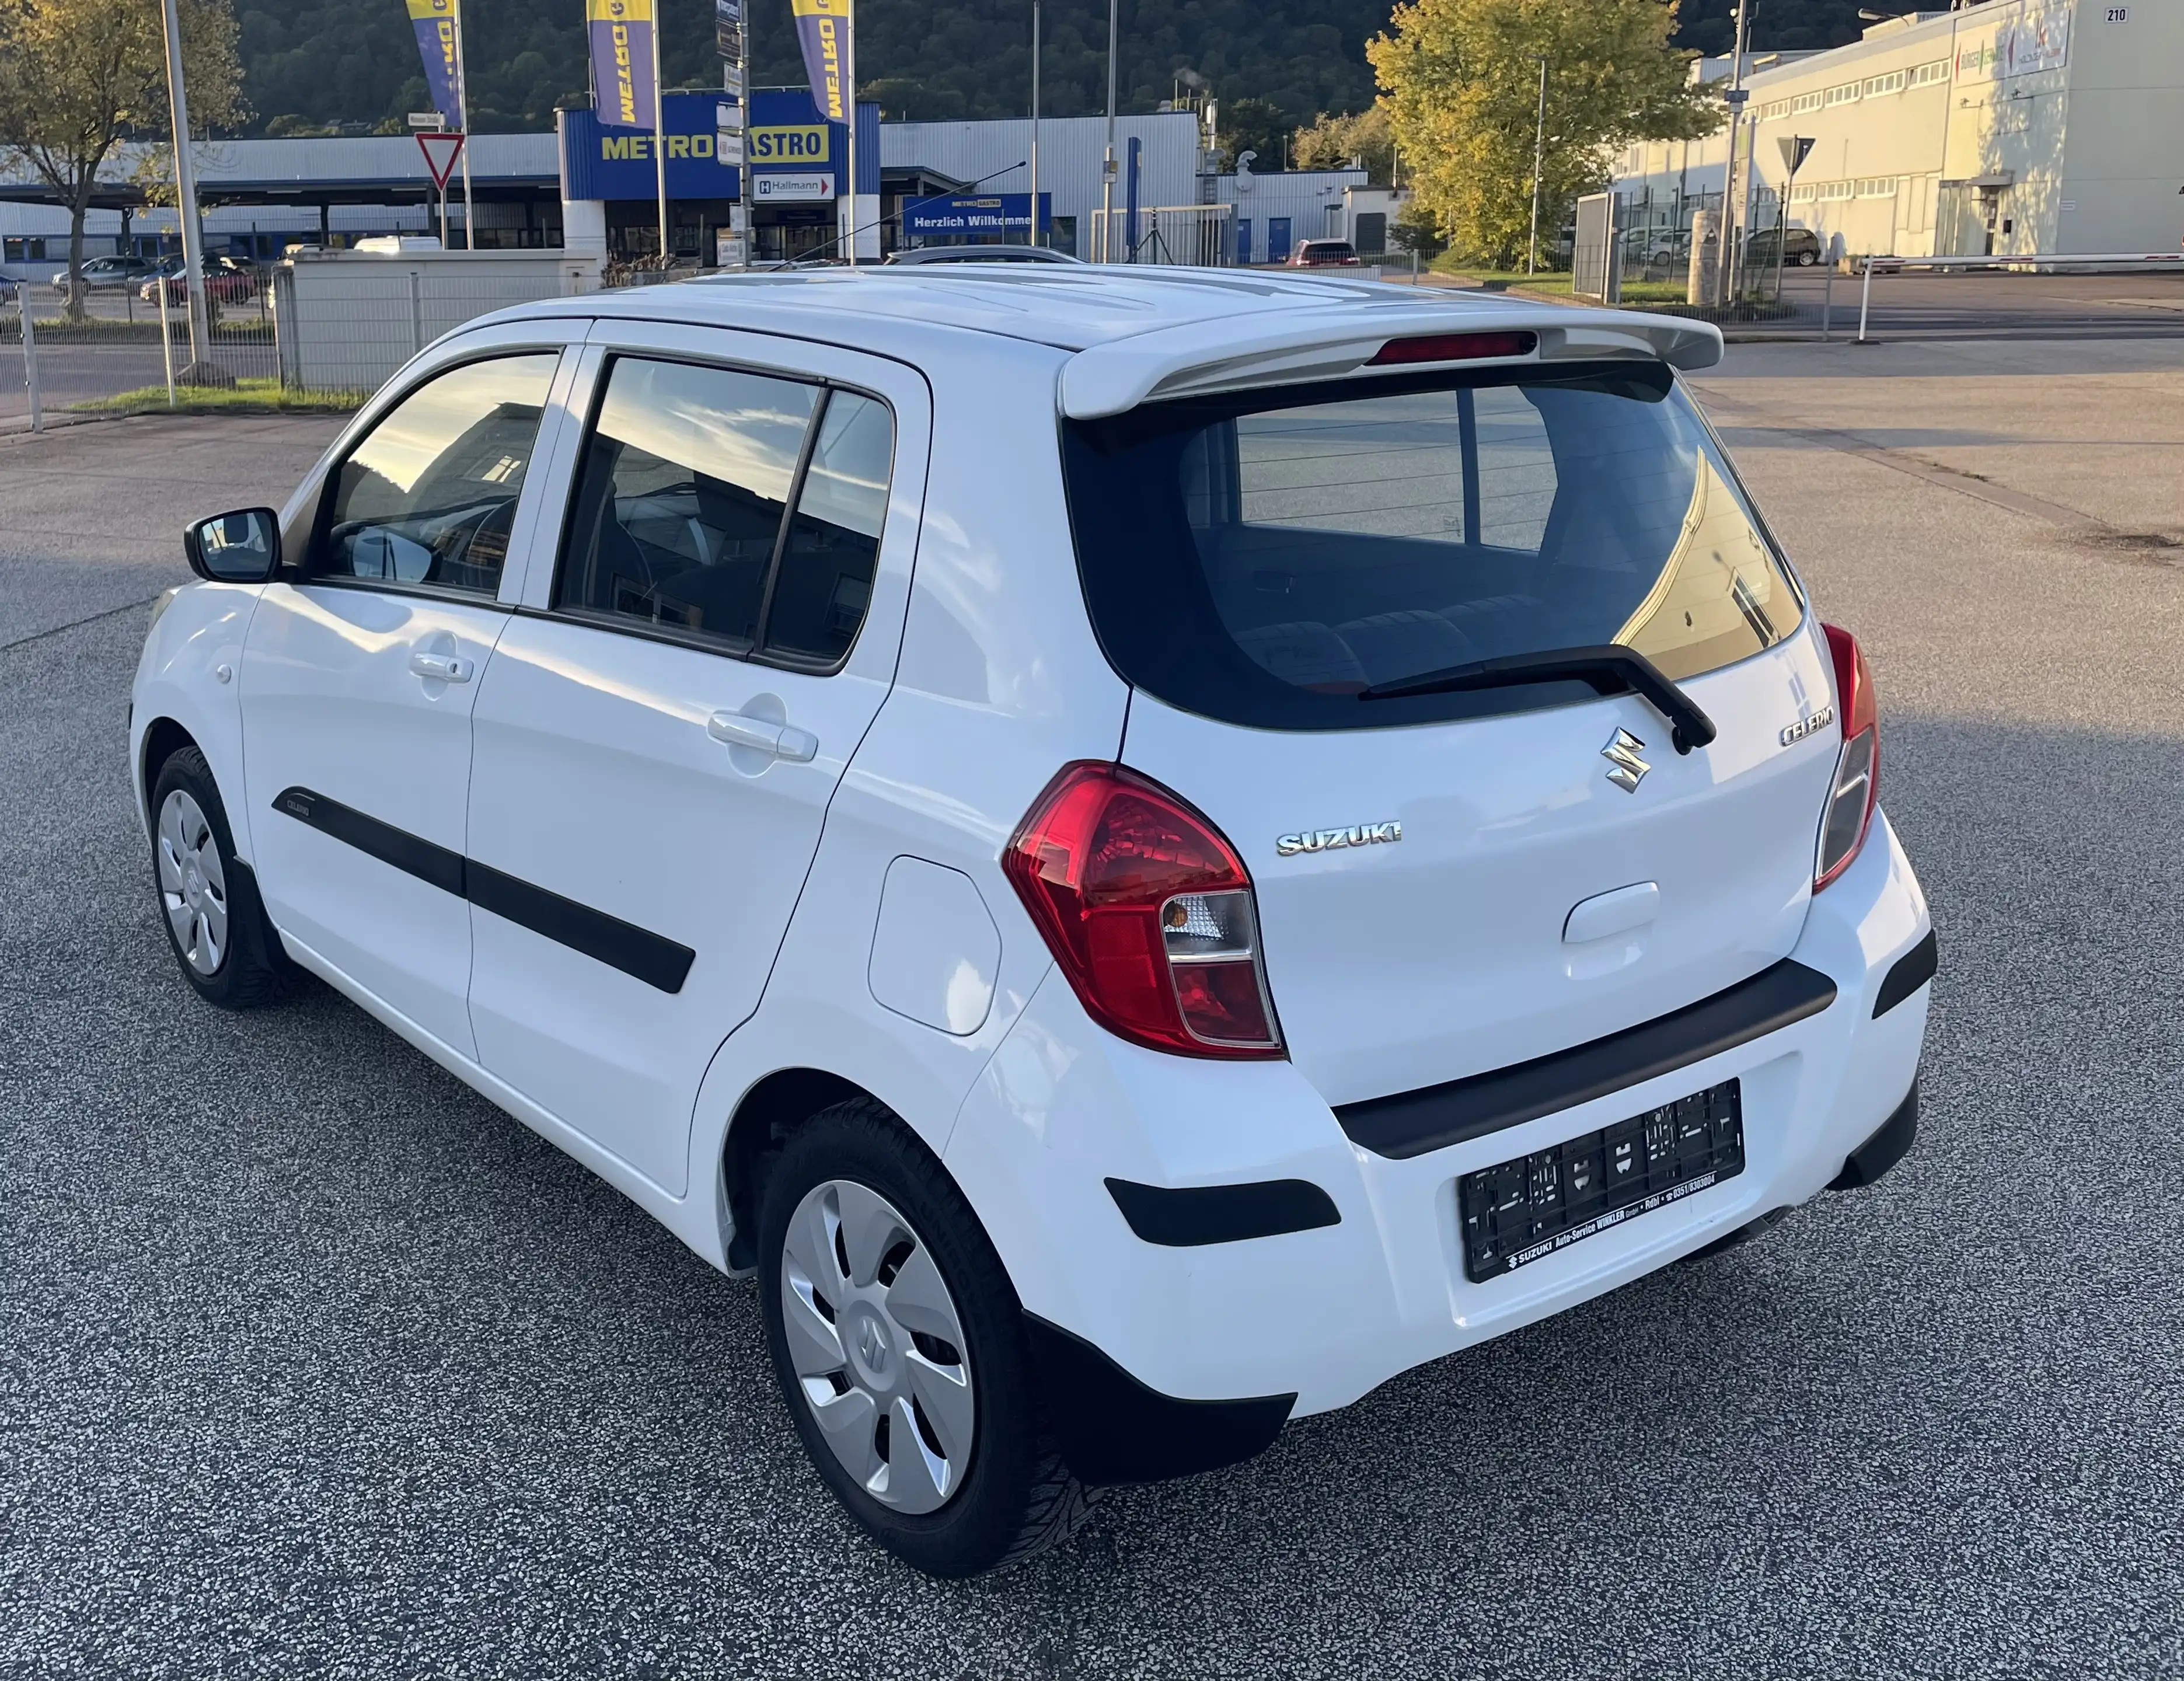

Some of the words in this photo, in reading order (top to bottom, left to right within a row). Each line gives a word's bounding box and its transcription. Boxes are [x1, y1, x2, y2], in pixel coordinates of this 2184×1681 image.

[2108, 9, 2125, 21] 210
[602, 135, 713, 160] METRO
[749, 132, 821, 157] ASTRO
[773, 182, 818, 190] Hallmann
[915, 216, 964, 227] Herzlich
[968, 216, 1032, 226] Willkomme
[1778, 705, 1834, 747] CELERIO
[1276, 819, 1402, 857] SUZUKI
[1519, 1241, 1552, 1264] SUZUKI
[1555, 1223, 1596, 1248] Auto-Service
[1596, 1209, 1625, 1230] WINKLER
[1645, 1196, 1660, 1210] Rdbl
